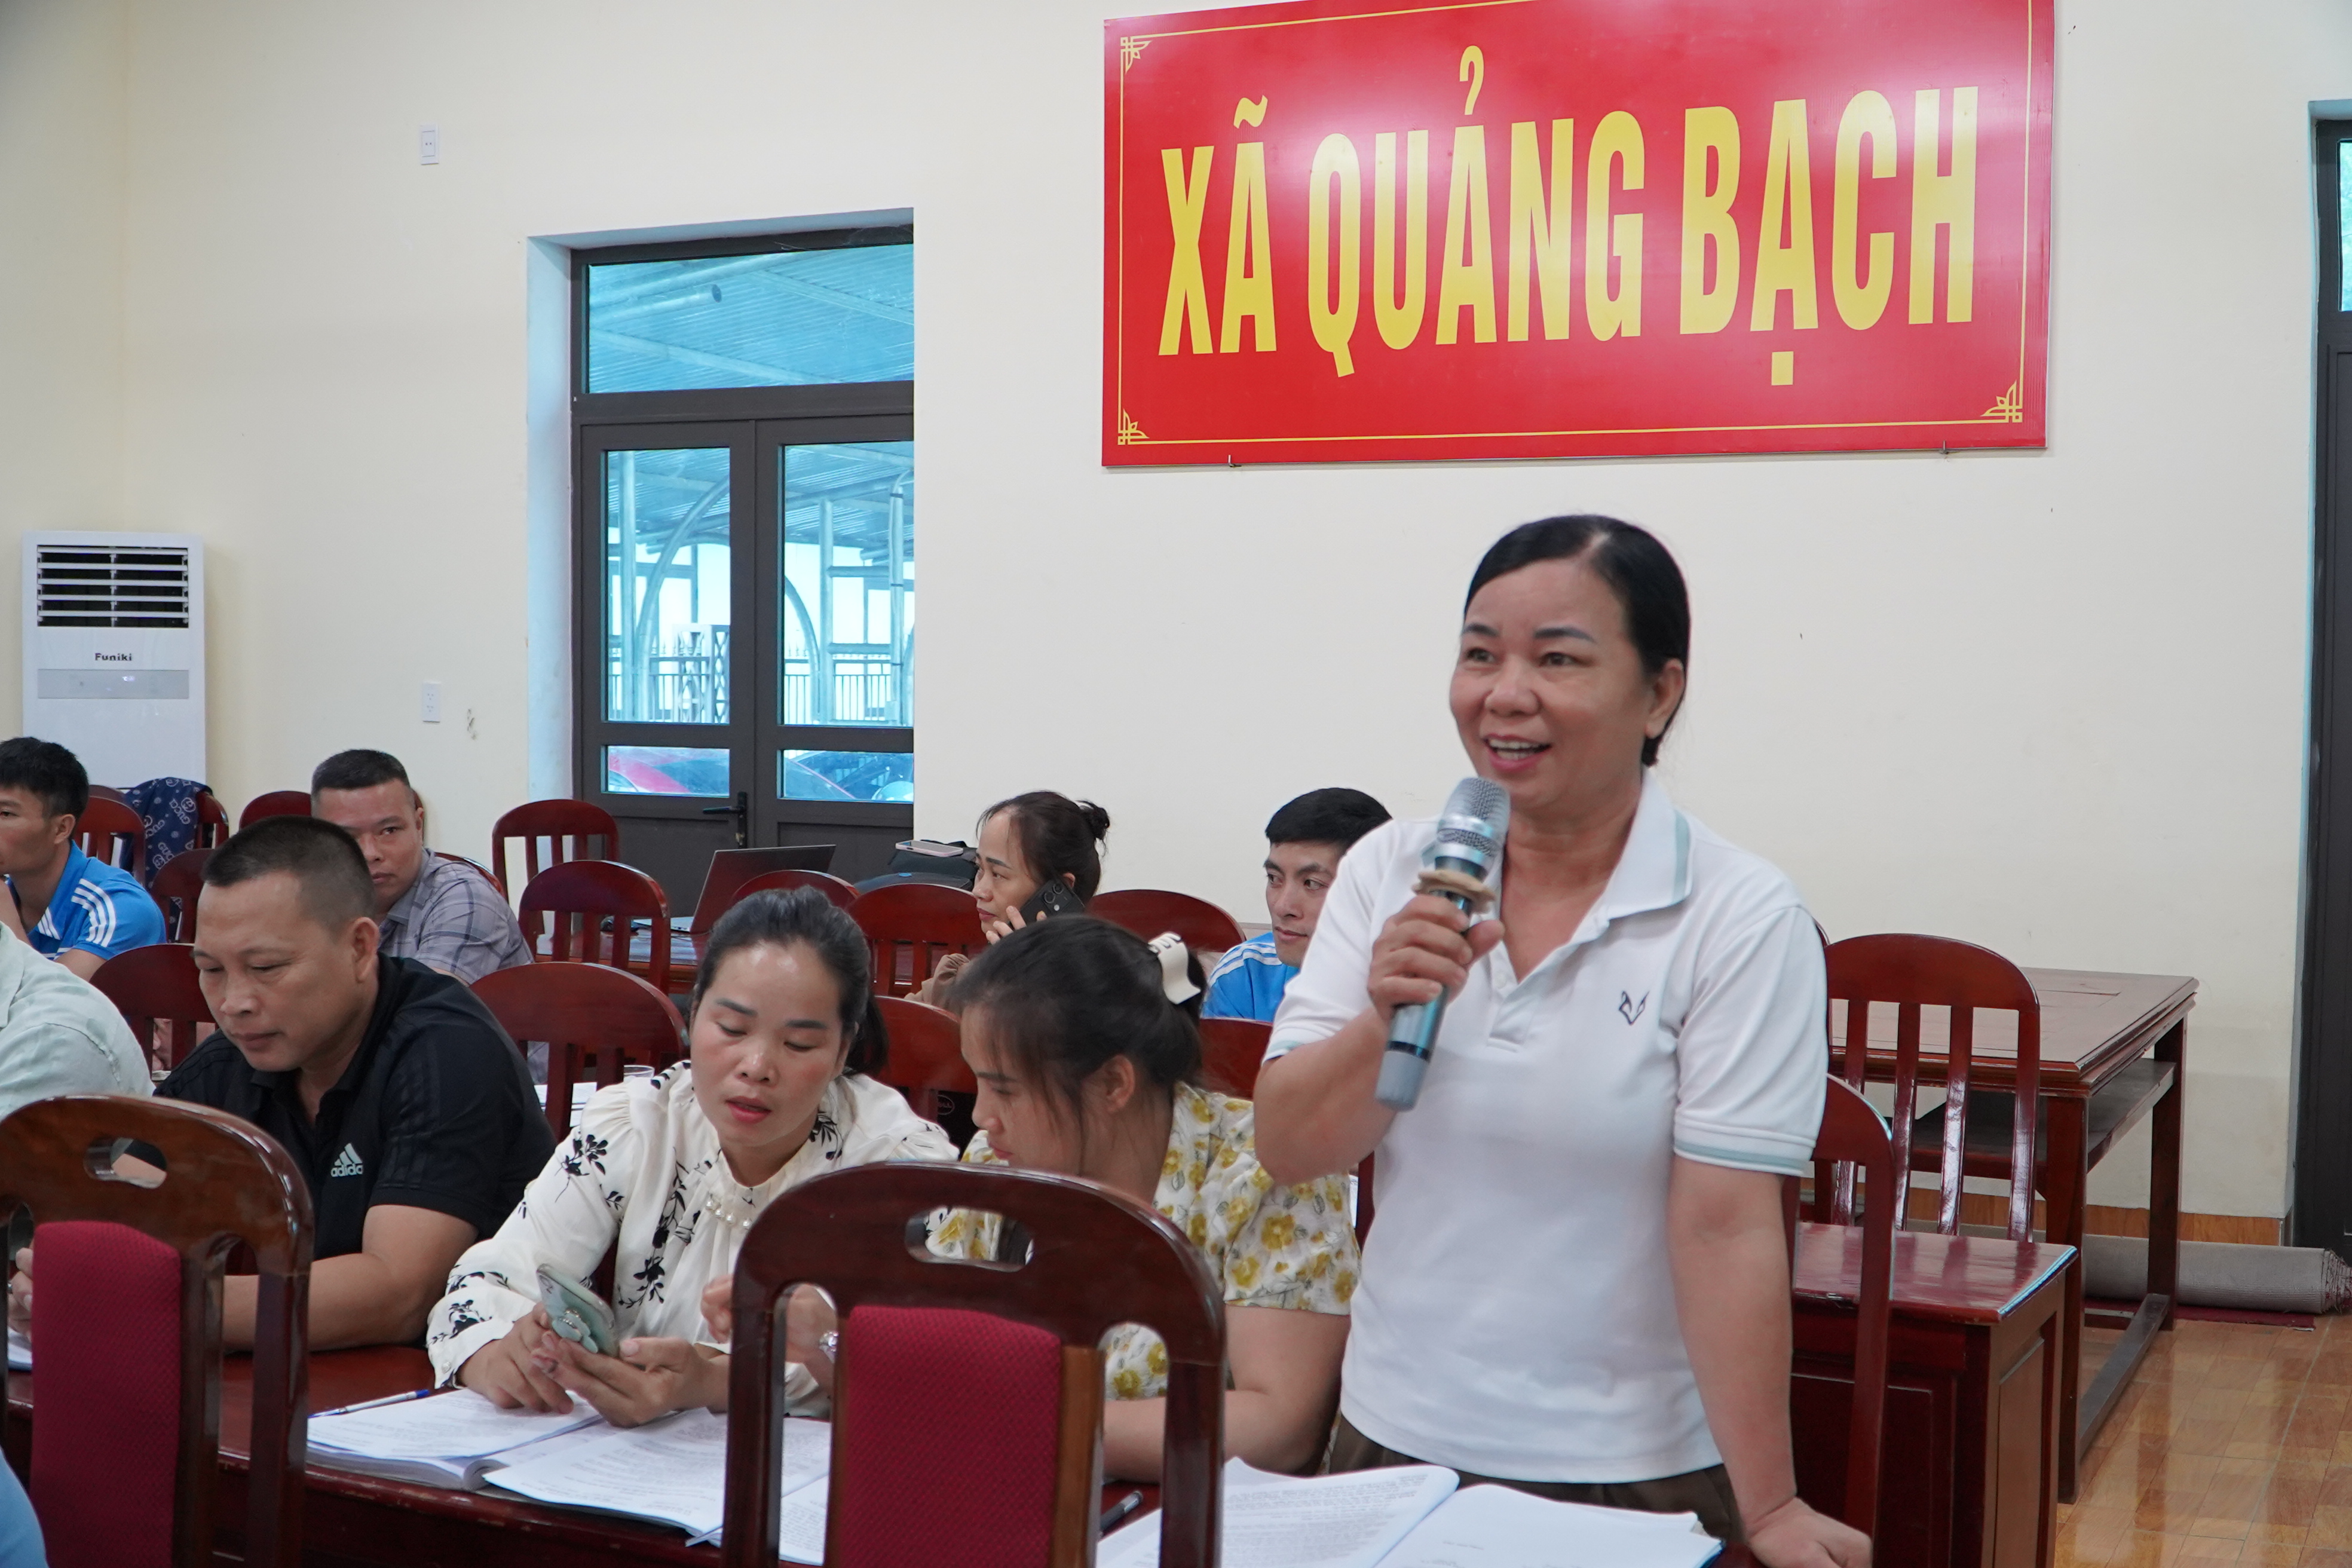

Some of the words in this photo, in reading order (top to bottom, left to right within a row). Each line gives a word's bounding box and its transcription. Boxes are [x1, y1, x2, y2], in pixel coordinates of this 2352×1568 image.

[1159, 96, 1276, 356] XÃ
[1309, 45, 1645, 377] QUẢNG
[1680, 85, 1979, 386] BẠCH
[169, 798, 190, 825] GUCCI
[145, 820, 165, 839] GUC
[158, 842, 174, 861] GUC
[330, 1163, 363, 1177] adida
